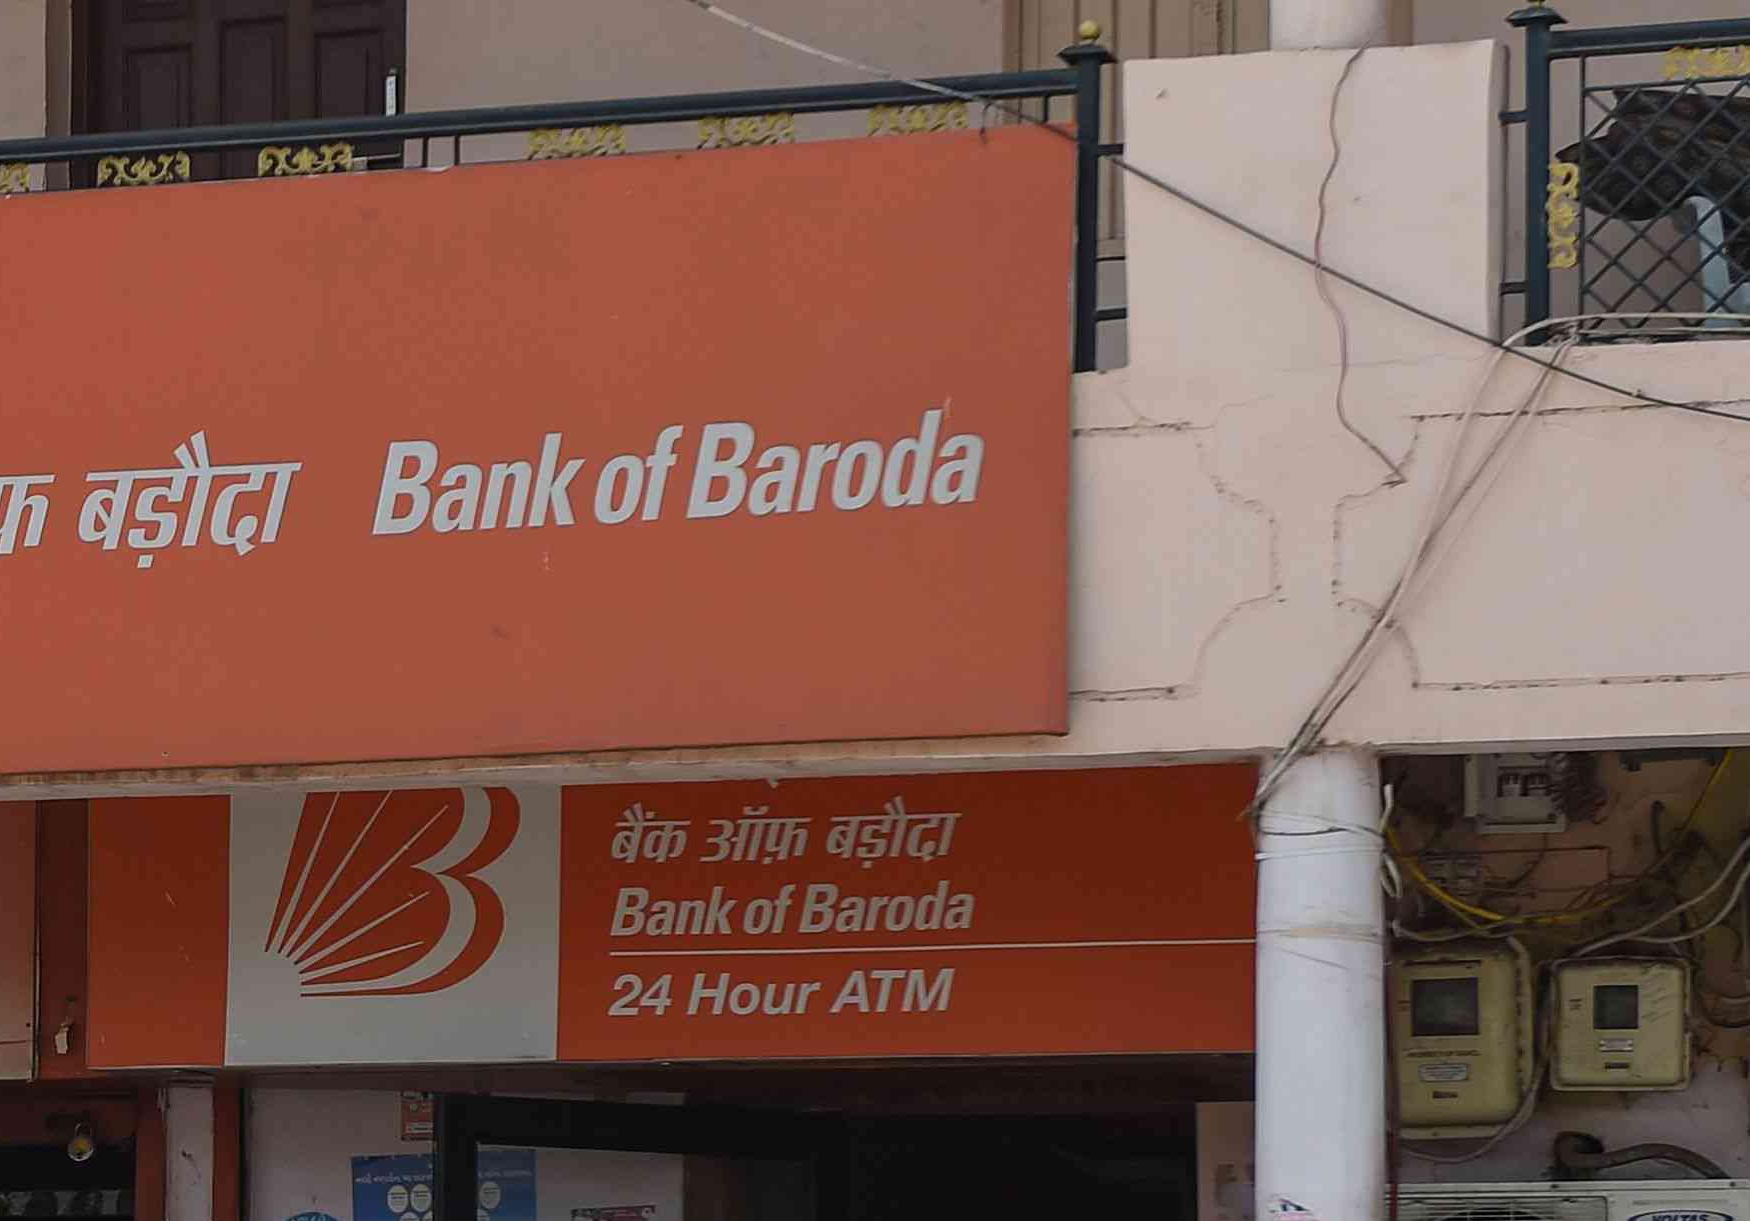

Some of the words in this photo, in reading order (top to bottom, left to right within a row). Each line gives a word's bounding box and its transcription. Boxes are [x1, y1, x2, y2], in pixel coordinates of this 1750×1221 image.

[78, 432, 302, 568] बड़ौदा
[372, 432, 585, 535] Bank
[594, 426, 682, 524] of
[687, 409, 985, 518] Baroda
[610, 802, 691, 864] बैंक
[825, 796, 962, 869] बड़ौदा
[610, 885, 735, 937] Bank
[742, 883, 797, 935] of
[798, 880, 975, 933] Baroda
[608, 973, 674, 1017] 24
[686, 971, 821, 1017] Hour
[829, 967, 955, 1013] ATM
